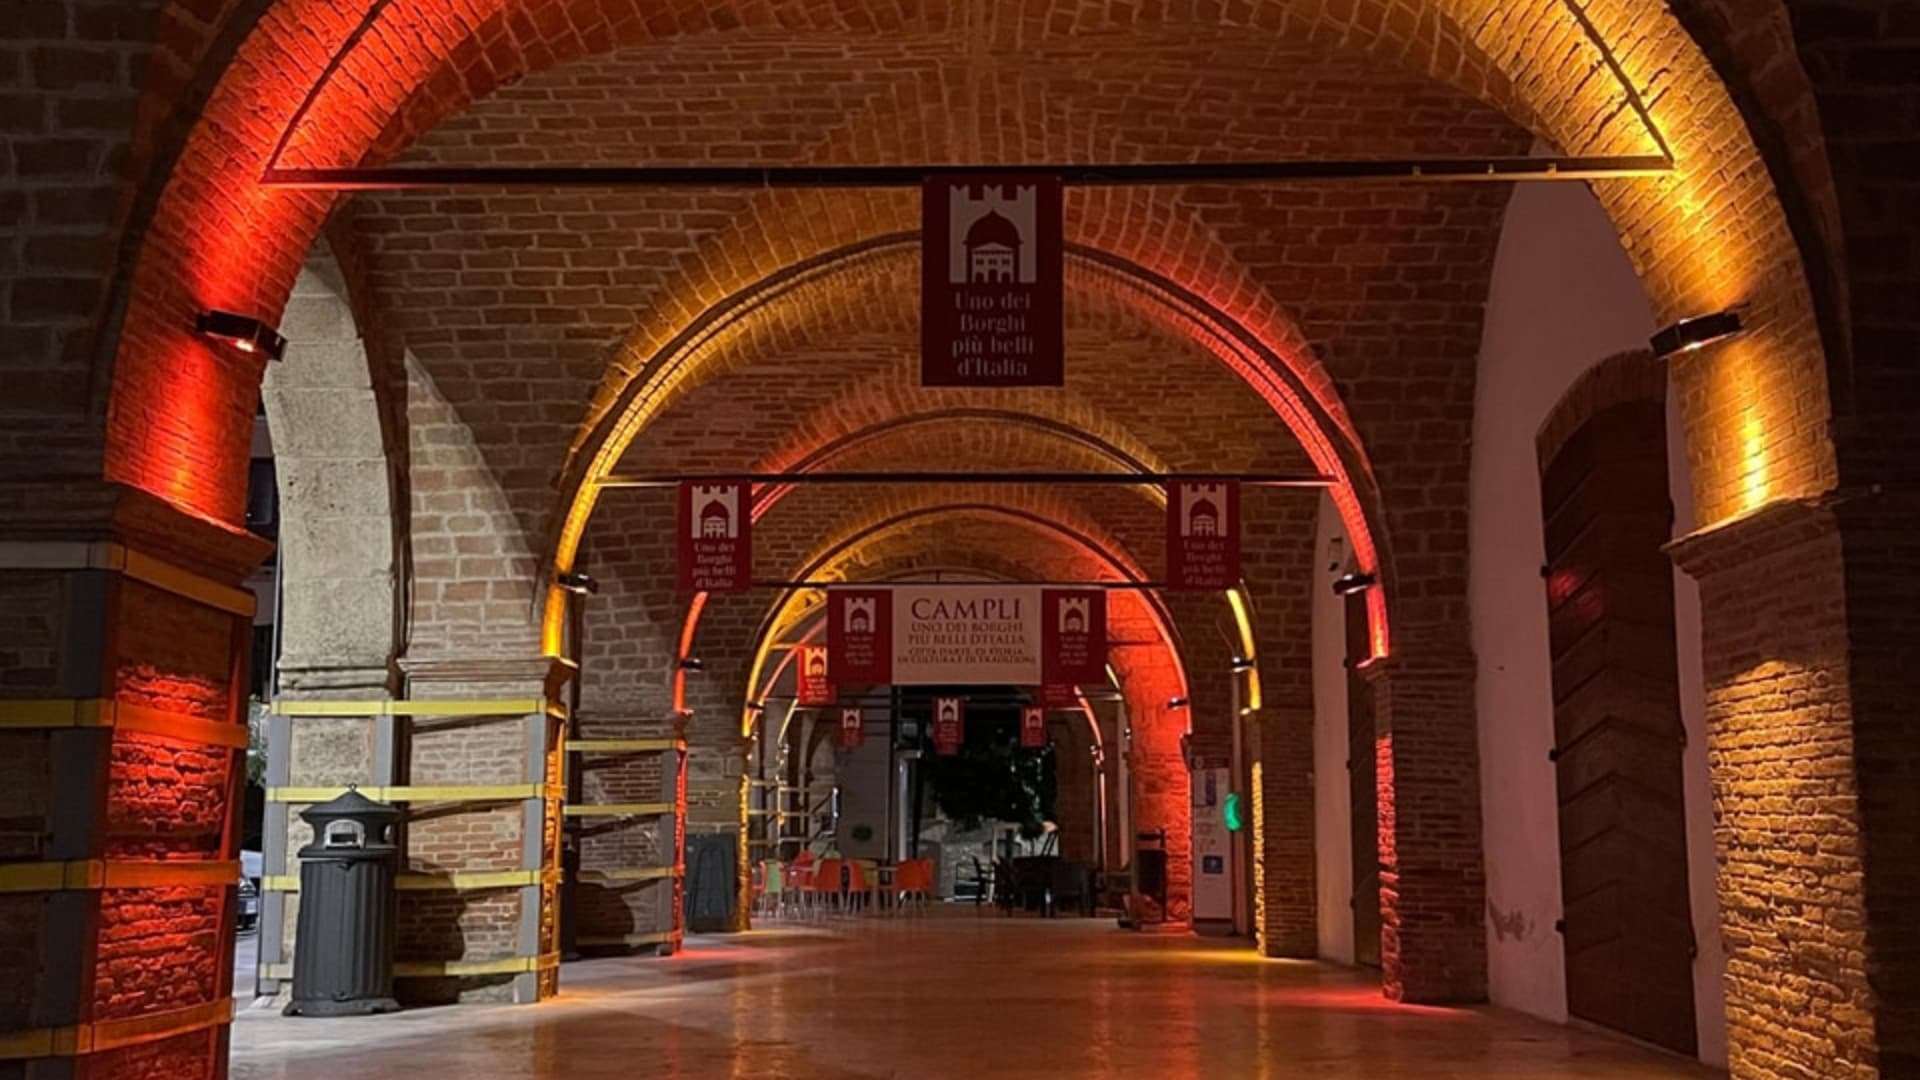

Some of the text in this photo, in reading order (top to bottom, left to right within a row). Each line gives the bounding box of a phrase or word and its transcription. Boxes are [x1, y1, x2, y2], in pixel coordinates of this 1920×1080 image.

[955, 291, 1030, 310] Uno dei
[961, 313, 1025, 334] Borghi
[952, 335, 1033, 359] più belli
[958, 357, 1028, 376] d'Italia
[911, 598, 1020, 620] CAMPLI
[911, 622, 1023, 633] UNO DEI BORGHI
